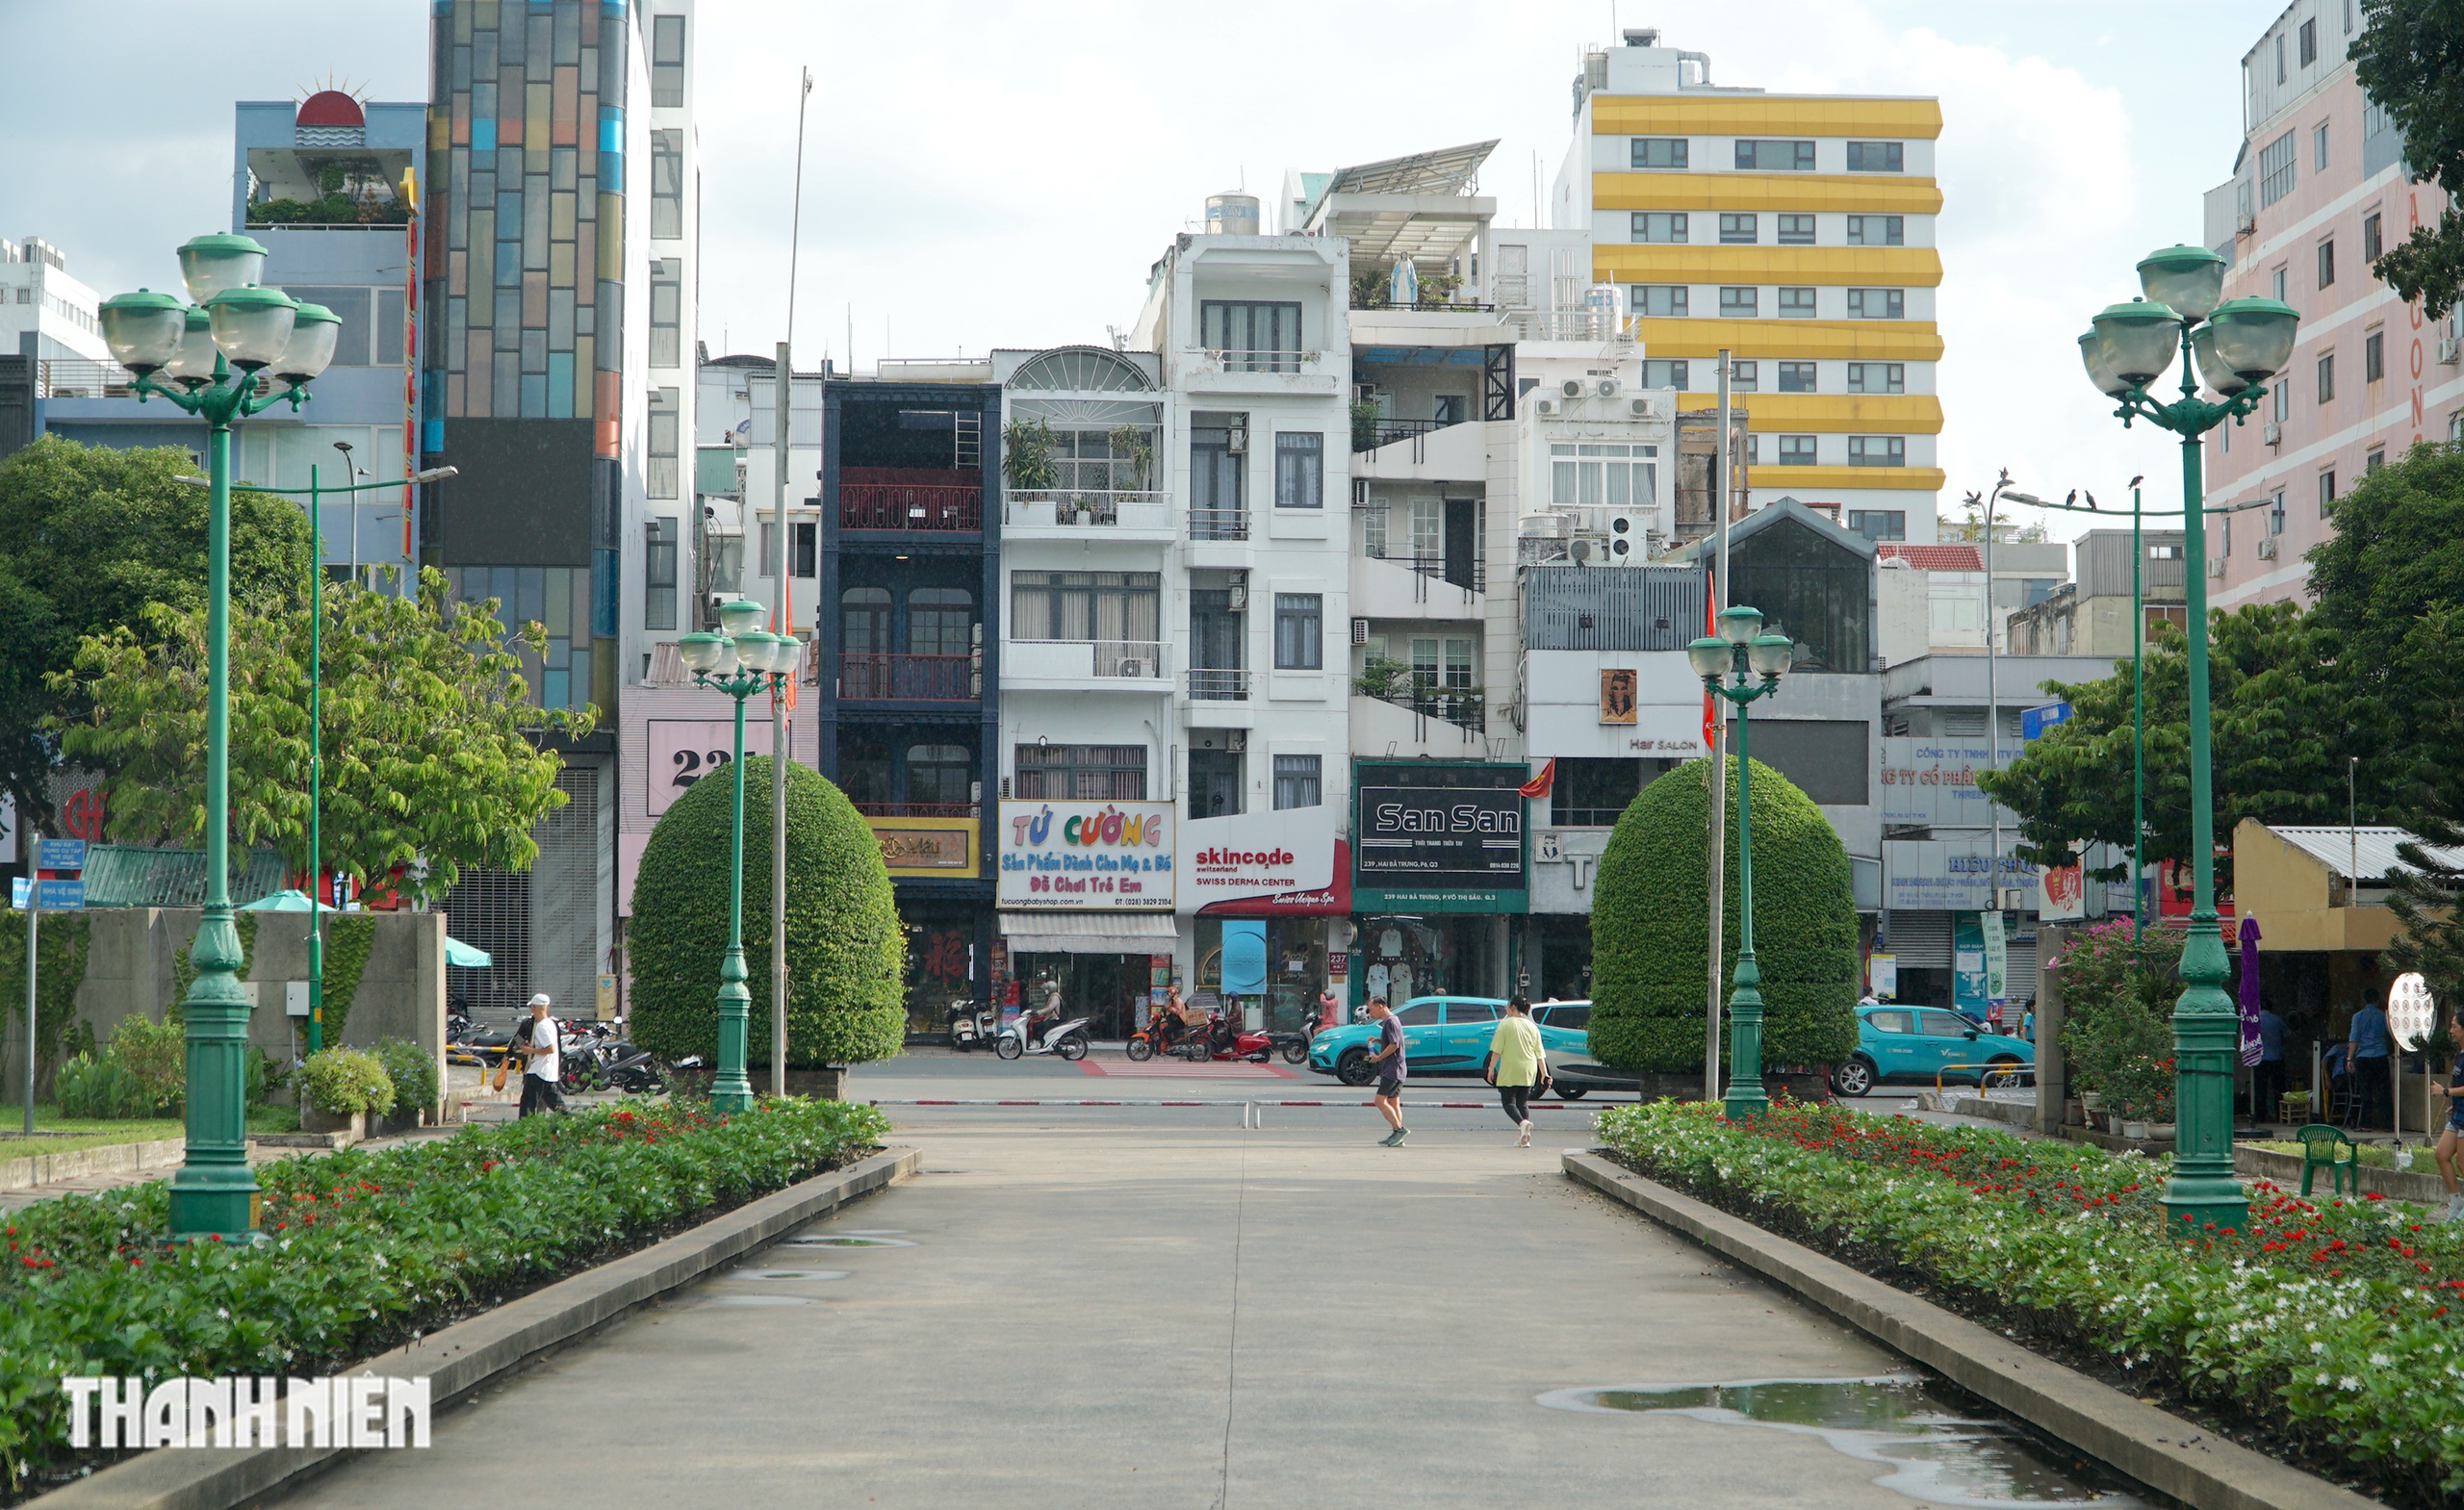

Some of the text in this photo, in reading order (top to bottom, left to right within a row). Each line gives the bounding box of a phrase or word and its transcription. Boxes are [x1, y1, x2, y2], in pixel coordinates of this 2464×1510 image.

[1630, 739, 1698, 750] Hair SALON
[1916, 747, 1944, 758] CÔNG
[1947, 750, 1960, 758] TY
[1964, 750, 1989, 758] TNHH
[1900, 770, 1916, 784] TY
[1014, 804, 1161, 847] TỨ CƯỜNG
[1376, 804, 1520, 832] San San
[1002, 852, 1172, 874] Sản Phẩm Dành Cho Mẹ & Bé
[1196, 848, 1294, 864] skincode
[1949, 854, 1992, 875] HIỆU
[1030, 875, 1142, 893] Đồ Chơi Trẻ Em
[1321, 892, 1335, 906] Spa
[1330, 955, 1347, 963] 237
